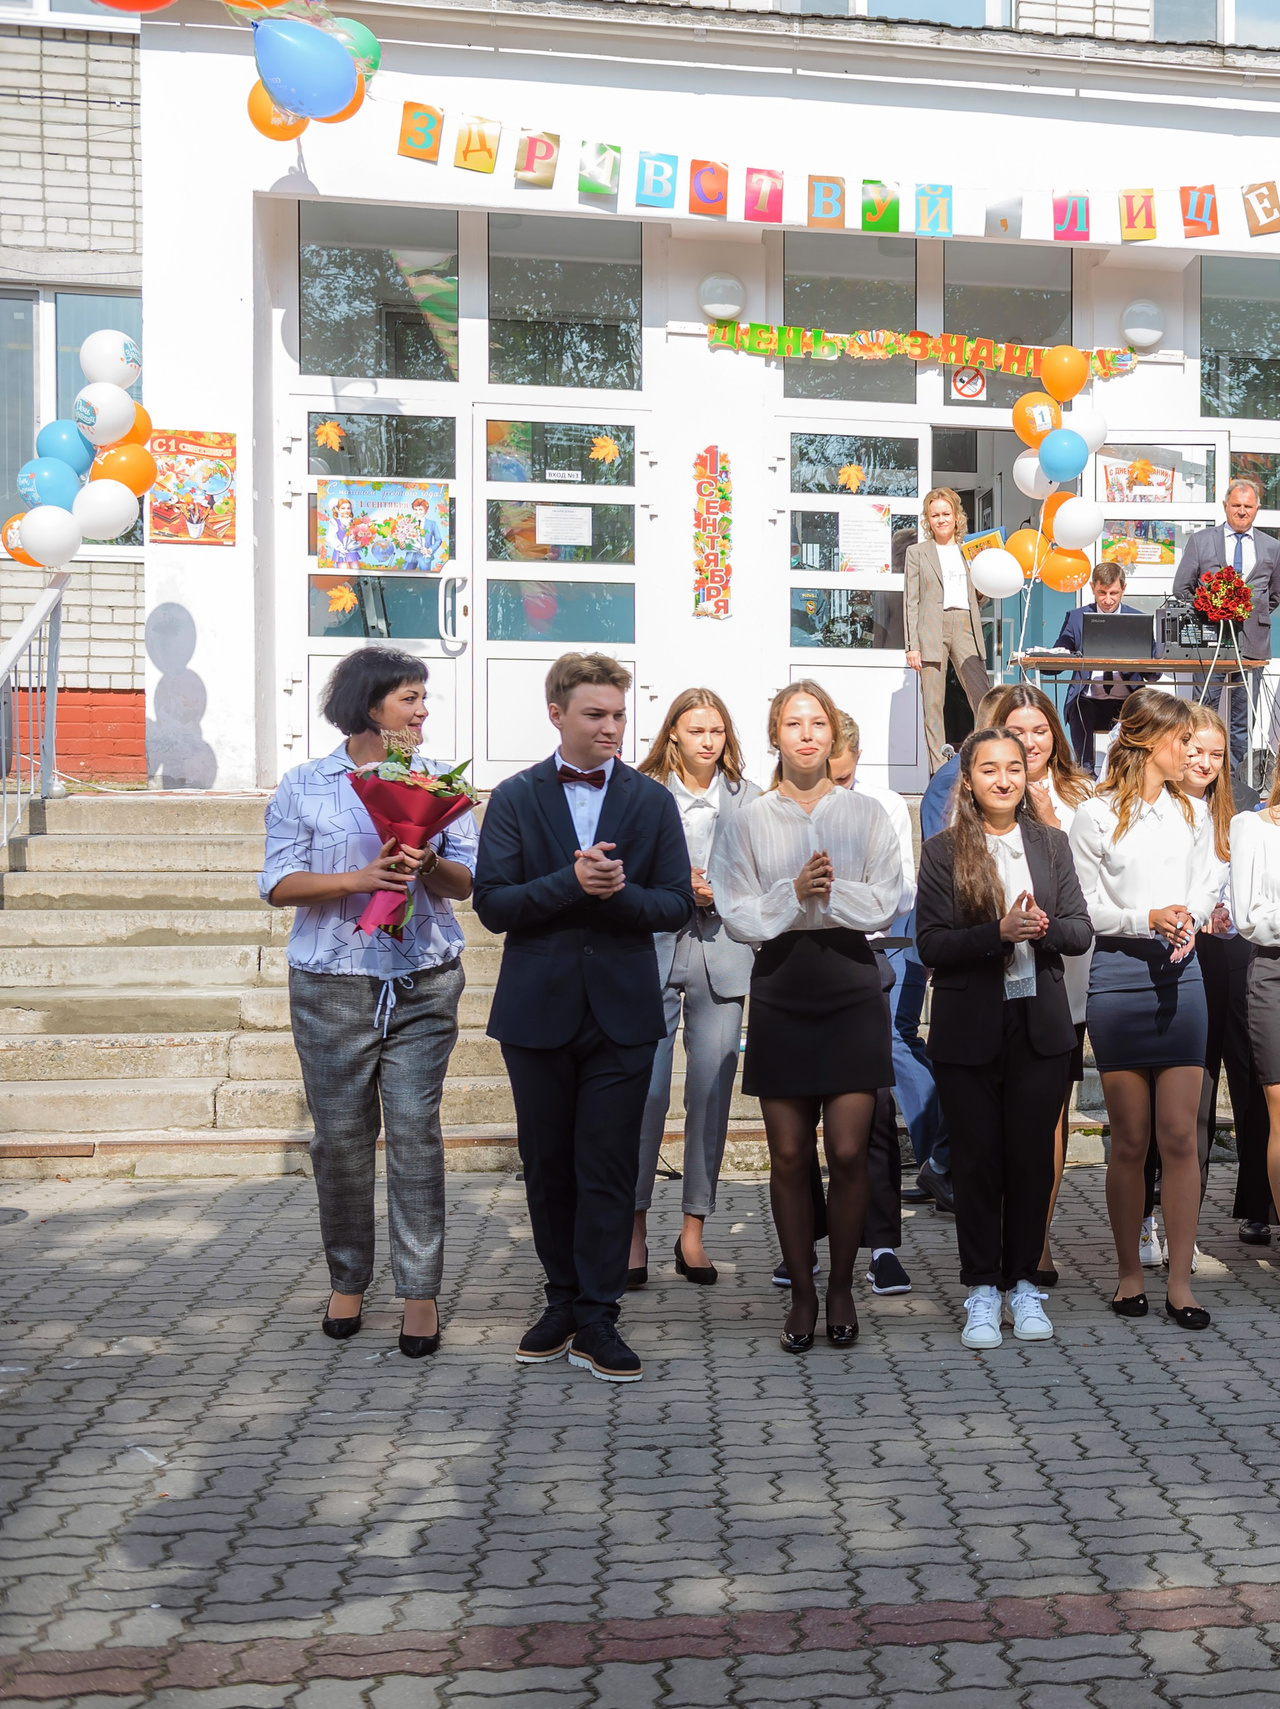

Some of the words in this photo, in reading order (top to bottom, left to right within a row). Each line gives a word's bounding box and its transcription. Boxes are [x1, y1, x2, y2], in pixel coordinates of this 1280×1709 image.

[709, 320, 837, 360] ДЕНЬ
[909, 331, 1110, 378] ЗНАН!
[153, 439, 167, 452] С
[168, 439, 177, 452] 1
[704, 445, 719, 475] 1
[326, 482, 338, 495] С
[359, 500, 364, 508] 1
[366, 501, 409, 509] СЕНТЯБРЯ
[696, 480, 728, 615] СЕНТЯБРЯ
